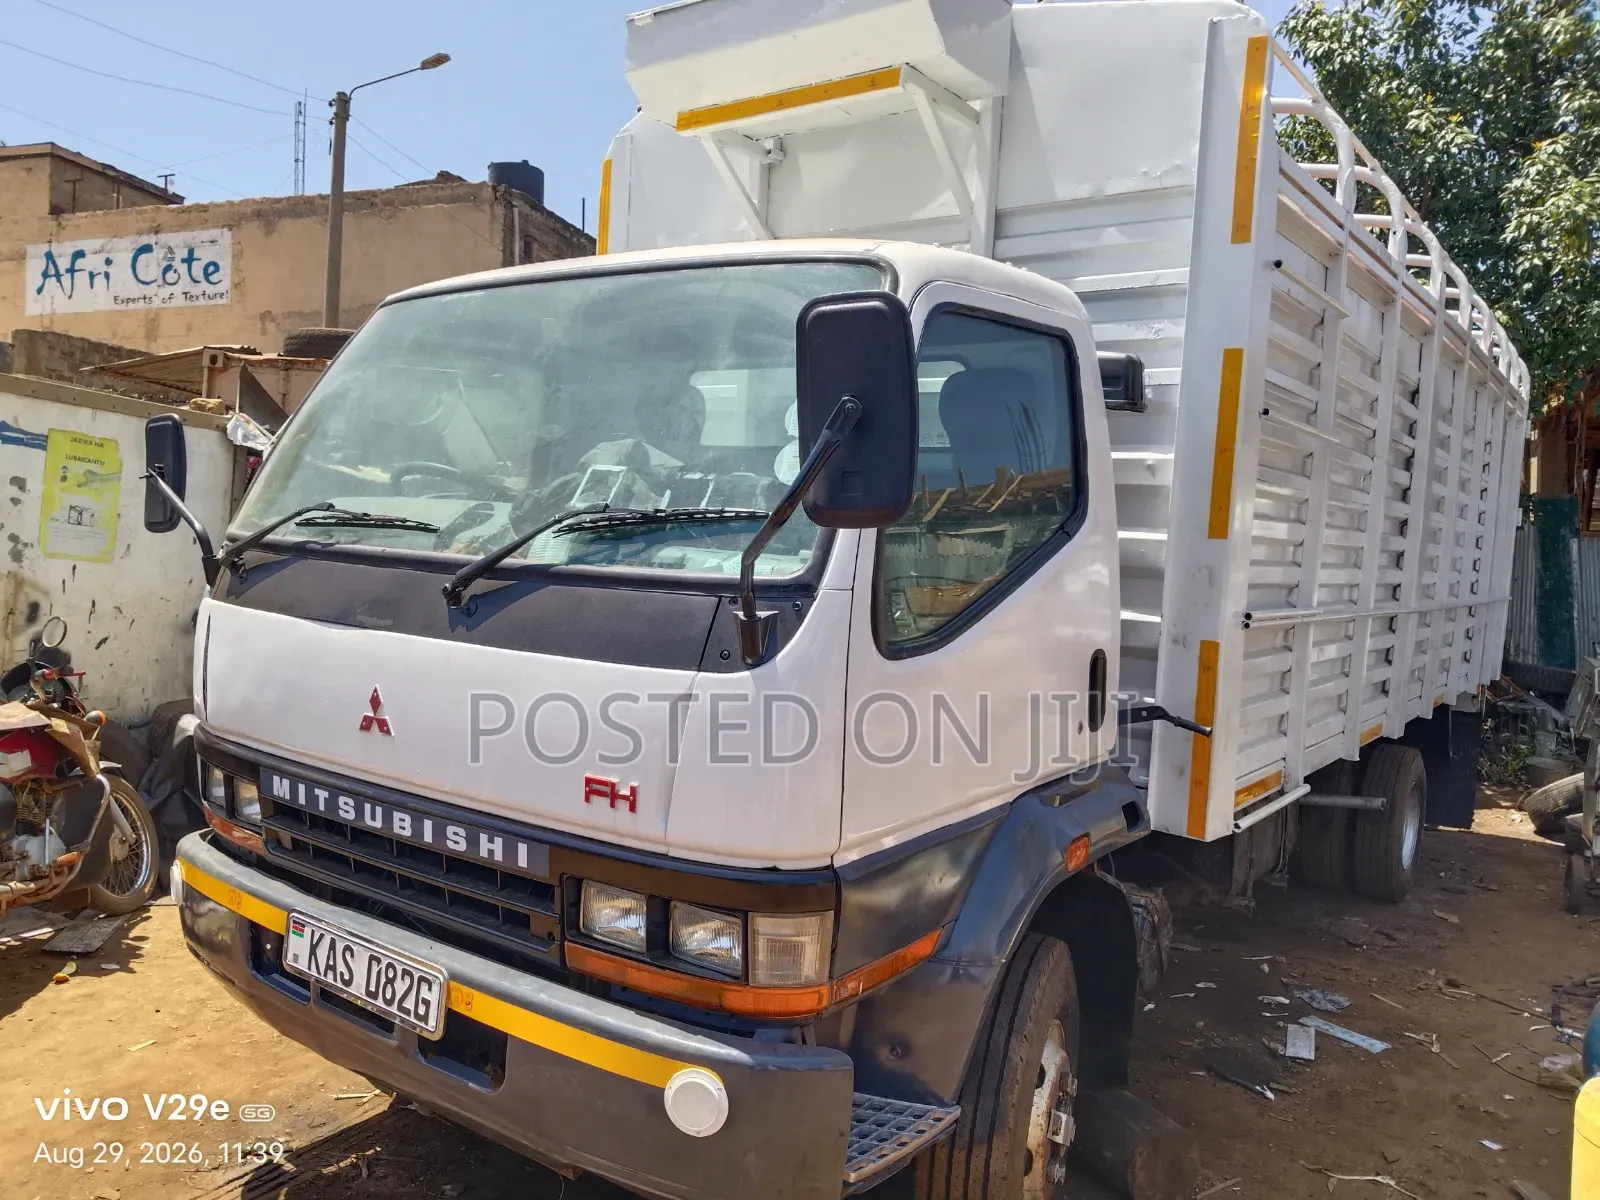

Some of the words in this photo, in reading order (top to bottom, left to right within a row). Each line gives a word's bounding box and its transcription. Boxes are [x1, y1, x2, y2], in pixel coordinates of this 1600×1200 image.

[36, 248, 113, 299] Afri
[113, 293, 153, 309] Experts
[162, 292, 175, 304] of
[182, 289, 229, 303] Texture!
[584, 773, 638, 814] FH
[271, 774, 529, 869] MITSUBISHI
[307, 928, 355, 988] KAS
